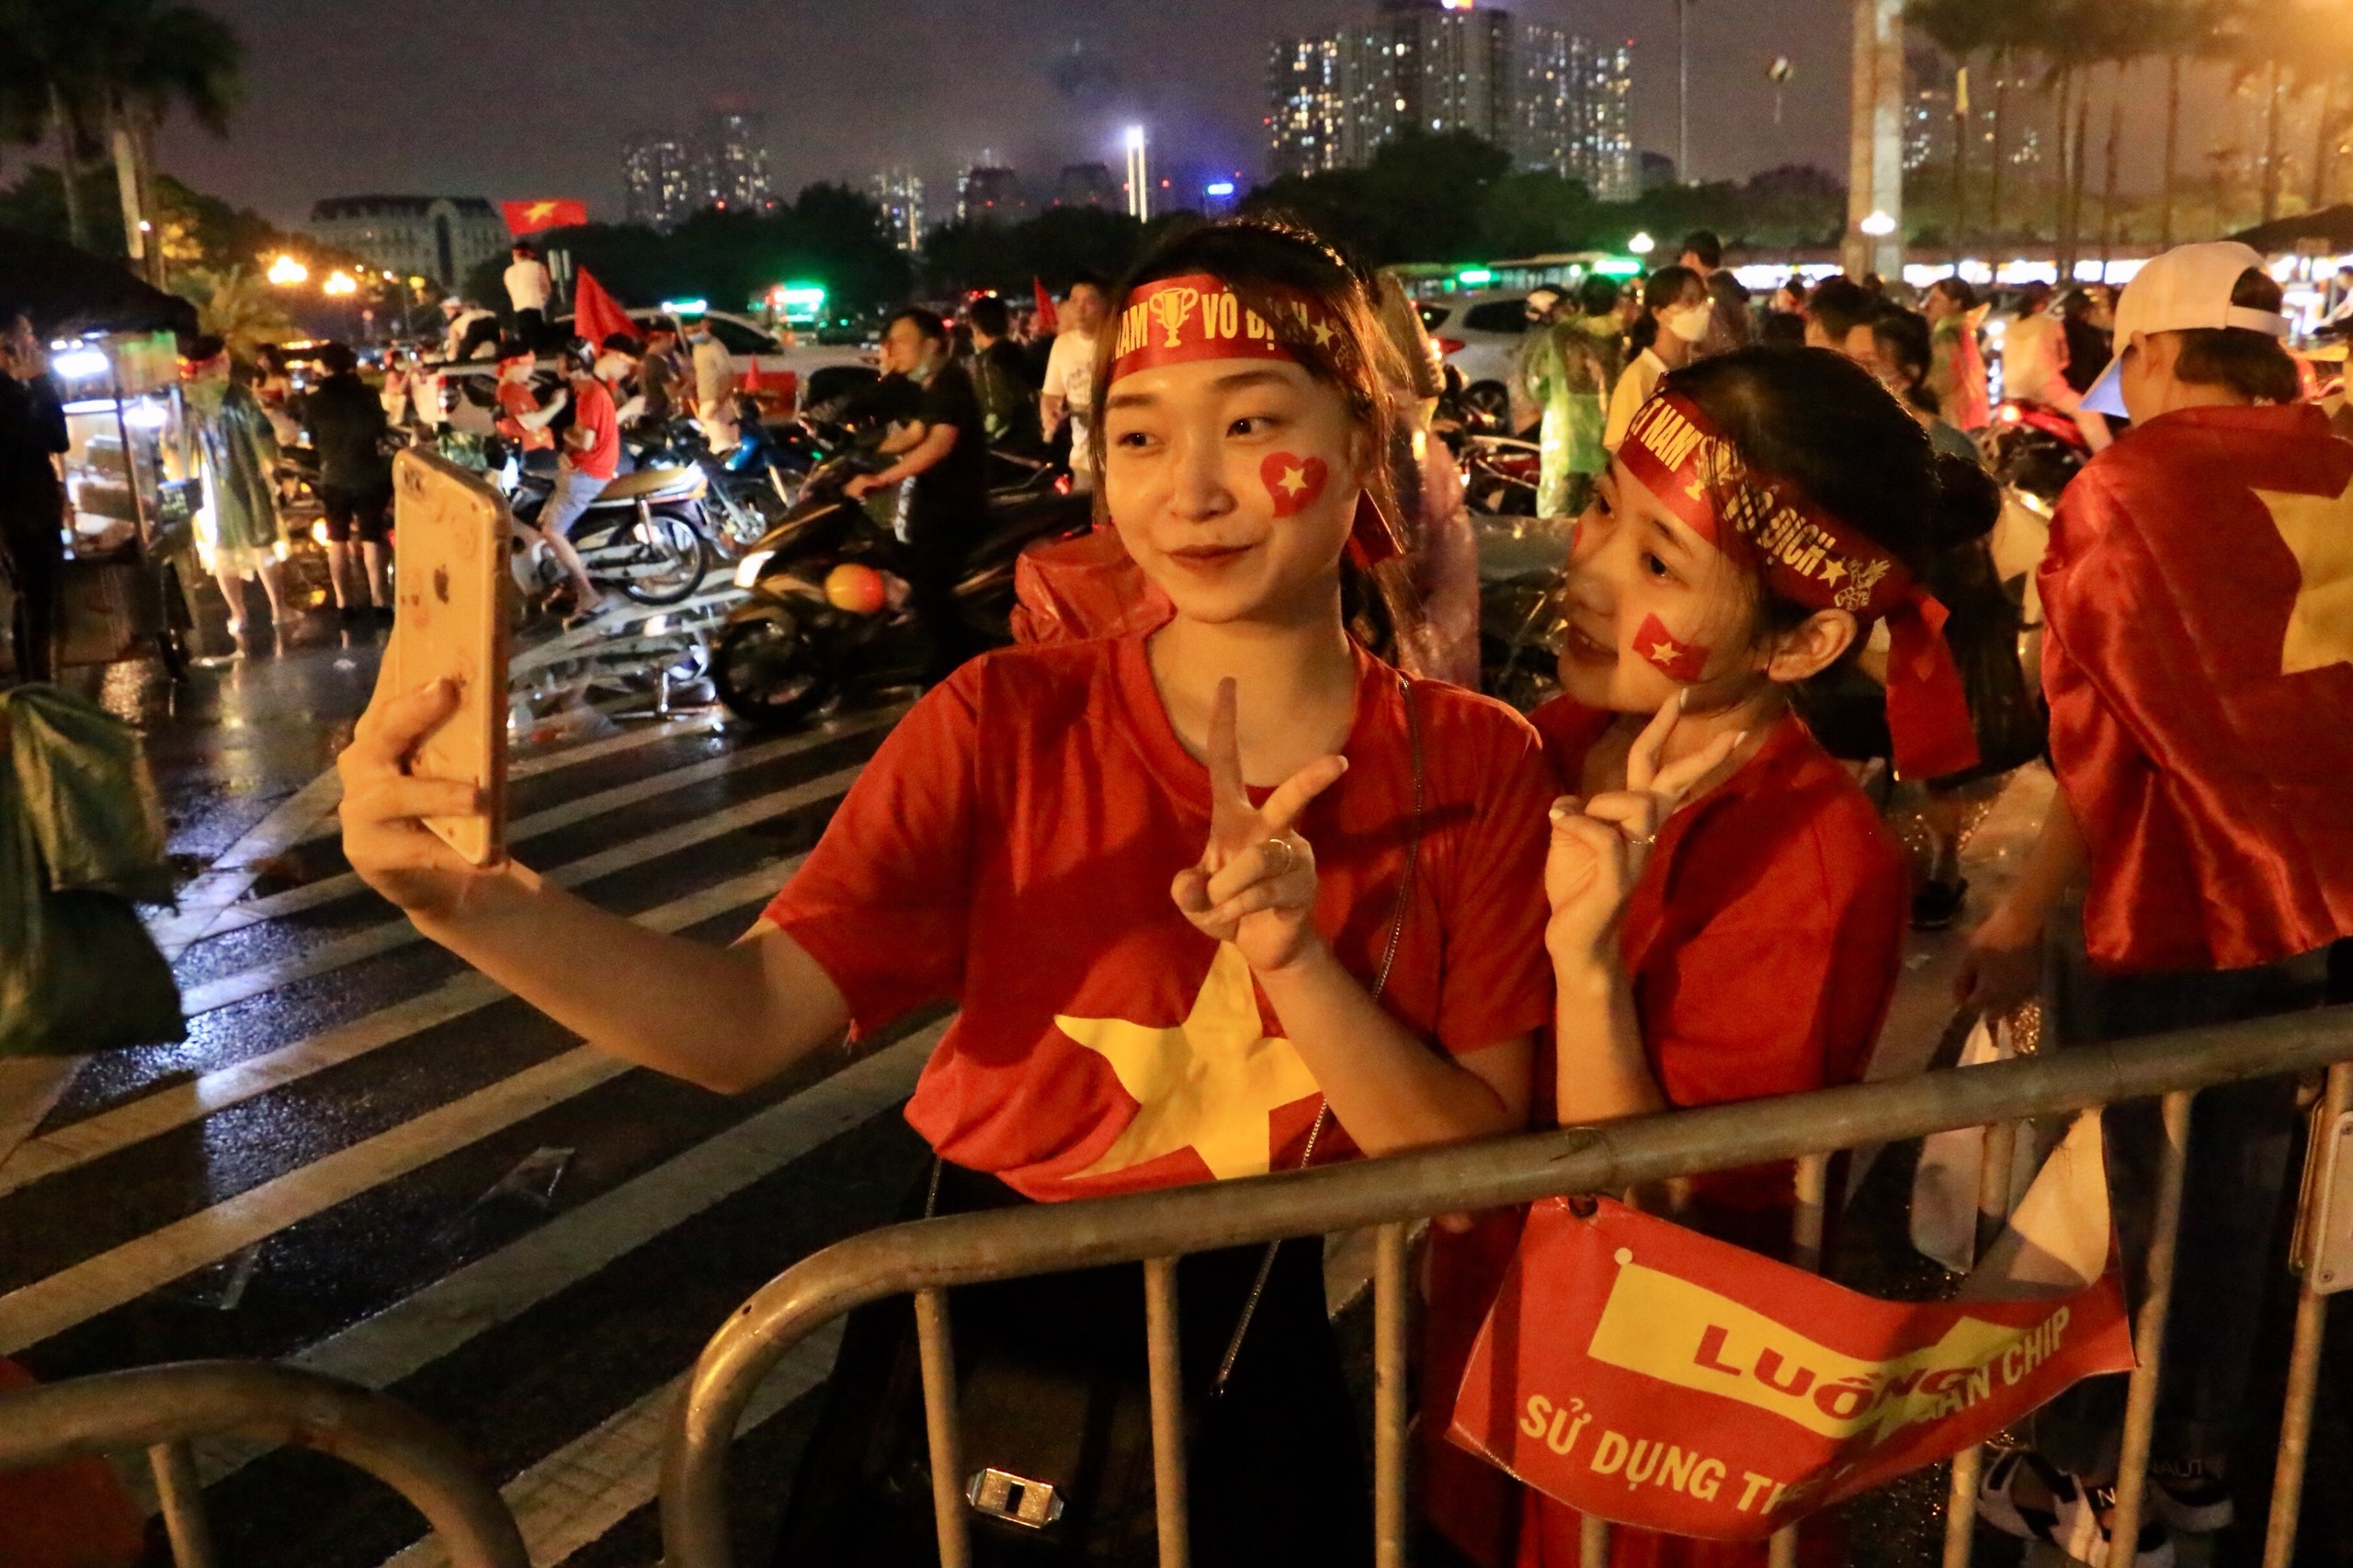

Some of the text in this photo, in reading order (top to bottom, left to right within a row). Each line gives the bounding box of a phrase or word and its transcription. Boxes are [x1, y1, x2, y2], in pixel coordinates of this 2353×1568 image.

[1640, 403, 1704, 472] NAM
[1519, 1394, 1593, 1455] SỬ
[1590, 1430, 1726, 1502] DỤNG
[2002, 1305, 2071, 1386] CHIP
